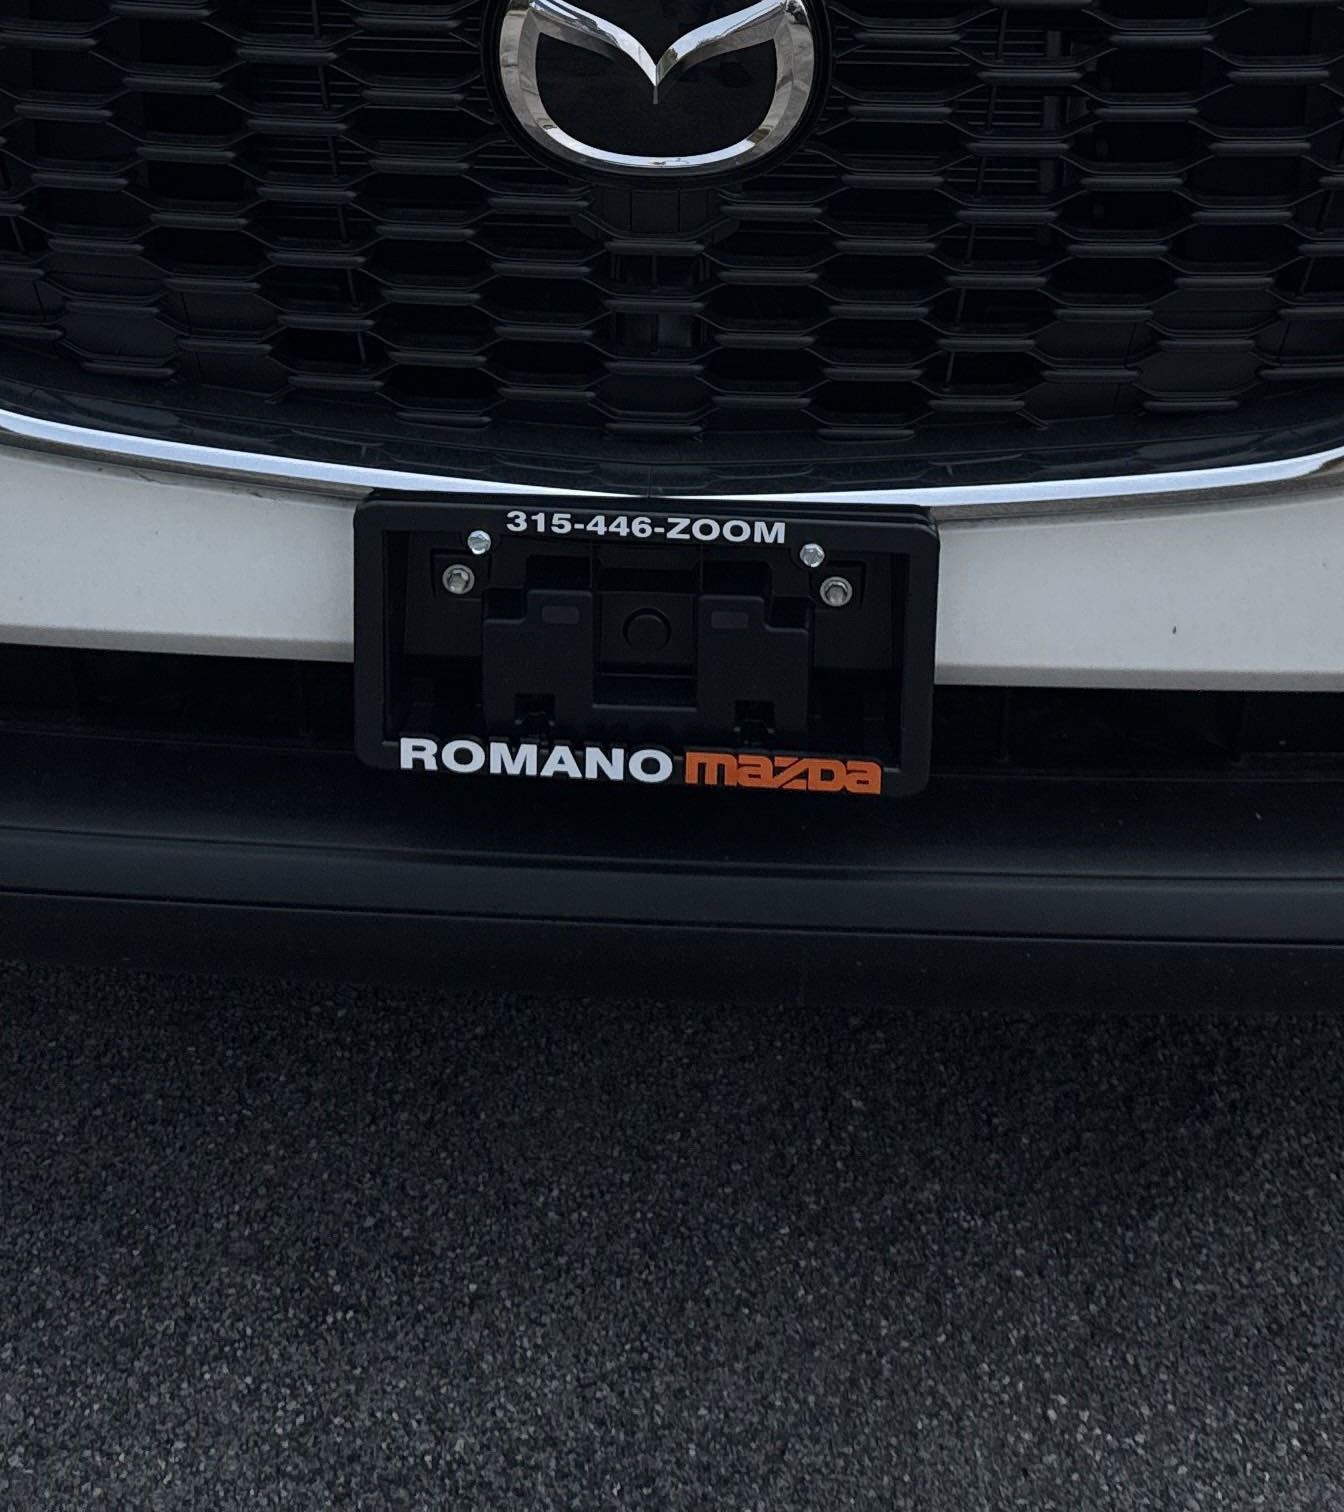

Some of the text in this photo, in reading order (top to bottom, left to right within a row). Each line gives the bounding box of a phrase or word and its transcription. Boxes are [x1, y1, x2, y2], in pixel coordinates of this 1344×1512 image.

[506, 510, 787, 545] 315-446-ZOOM
[399, 737, 882, 795] ROMANO mazda
